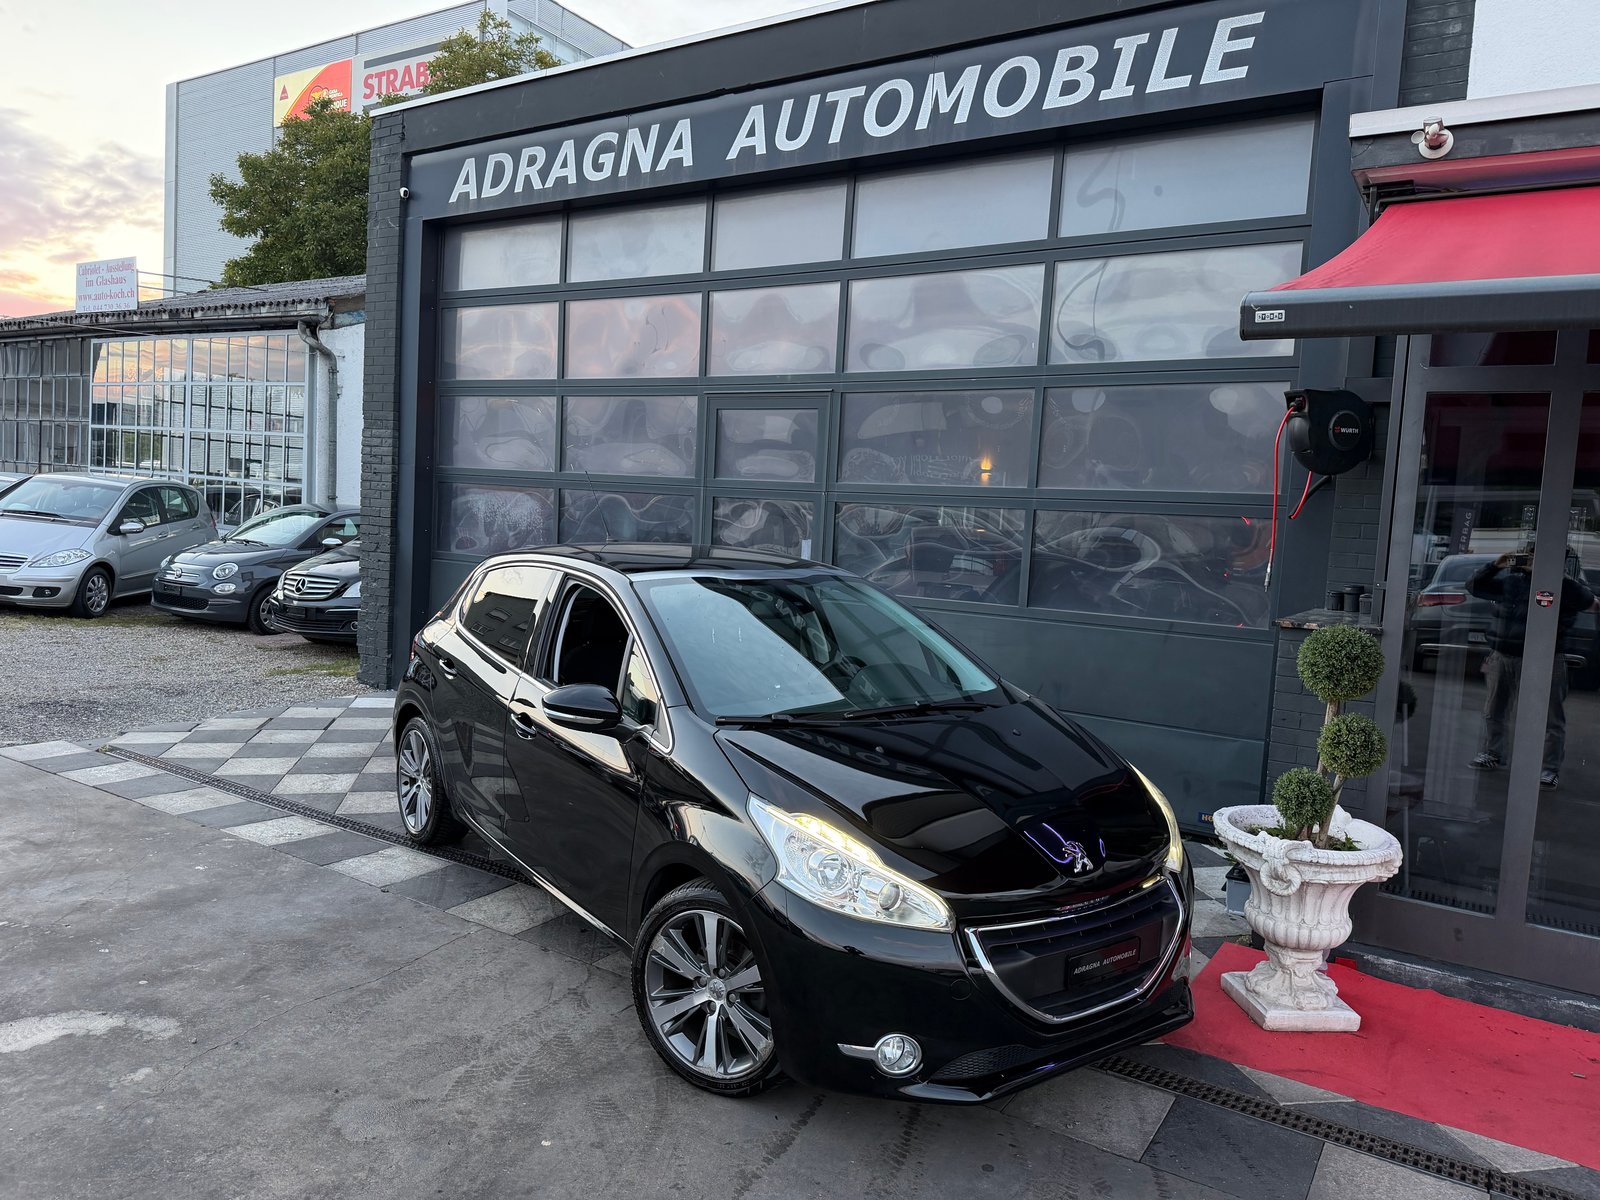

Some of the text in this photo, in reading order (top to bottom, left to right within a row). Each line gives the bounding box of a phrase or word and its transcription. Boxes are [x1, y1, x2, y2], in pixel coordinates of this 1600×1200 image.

[363, 61, 444, 99] STRAB
[447, 11, 1266, 204] ADRAGNA AUTOMOBILE
[85, 275, 127, 287] im Glashaus
[78, 288, 135, 301] www.auto-koch.ch
[1073, 949, 1137, 975] ADRAGNA AUTOMOBILE
